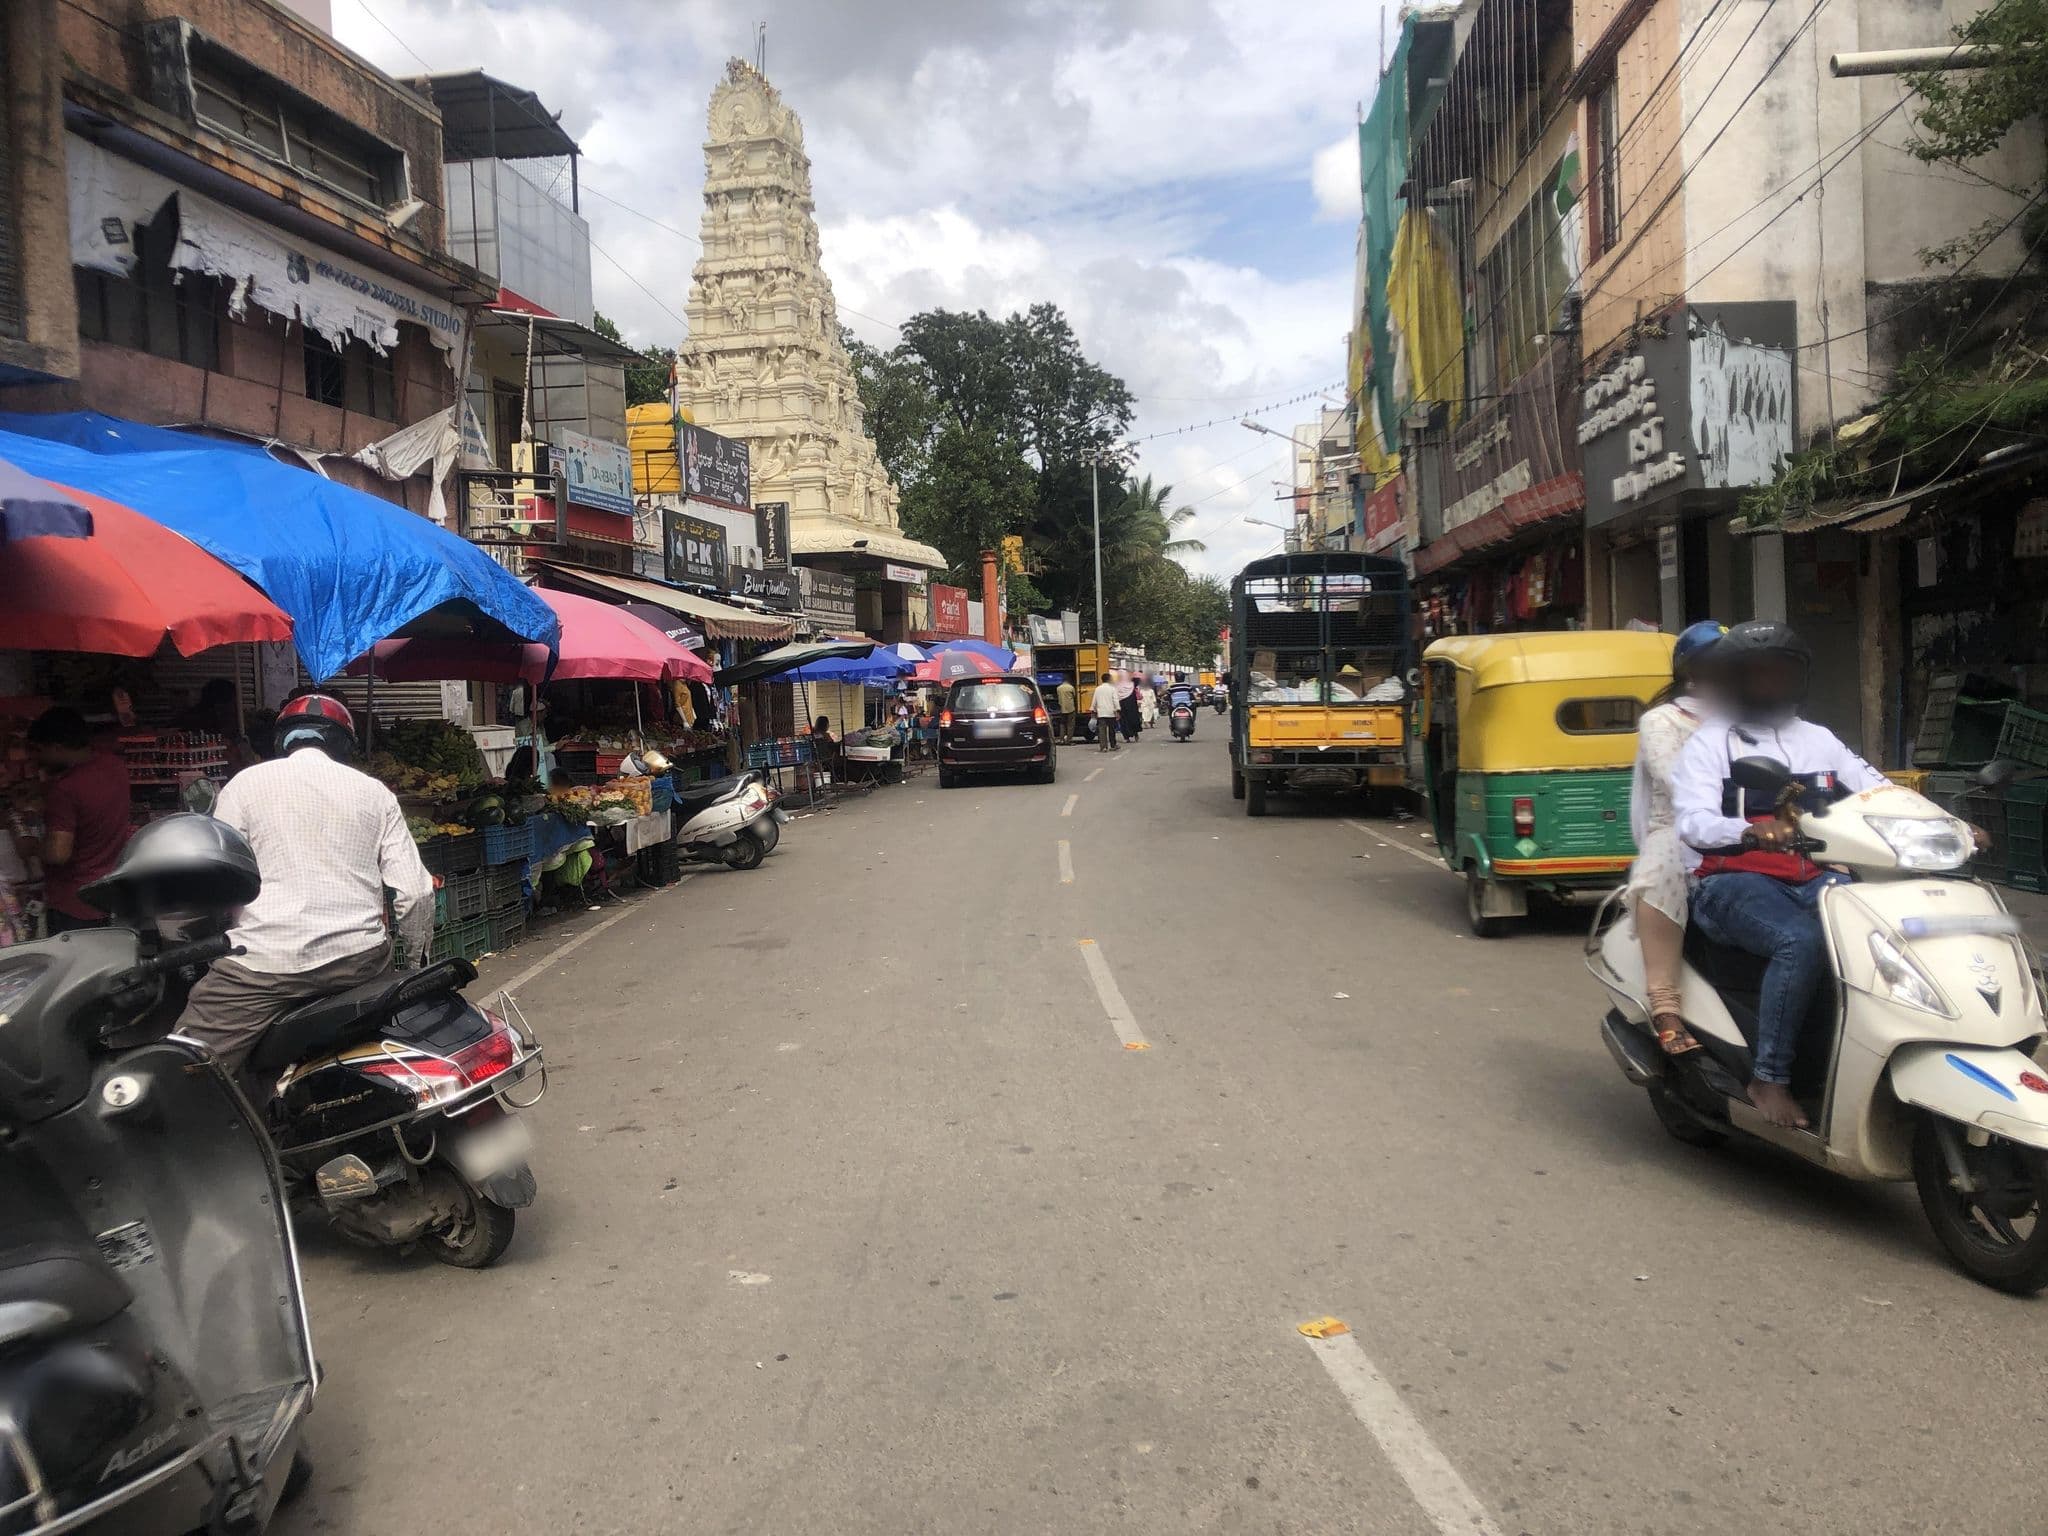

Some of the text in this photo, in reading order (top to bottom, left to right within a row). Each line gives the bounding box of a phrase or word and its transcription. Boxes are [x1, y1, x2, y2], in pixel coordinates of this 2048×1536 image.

[420, 304, 461, 336] STUDIO
[591, 466, 618, 486] DARBAR
[686, 539, 713, 566] P.K
[744, 574, 765, 594] Bharat
[832, 601, 844, 612] METAL
[844, 602, 854, 613] MART
[946, 599, 960, 616] airtel
